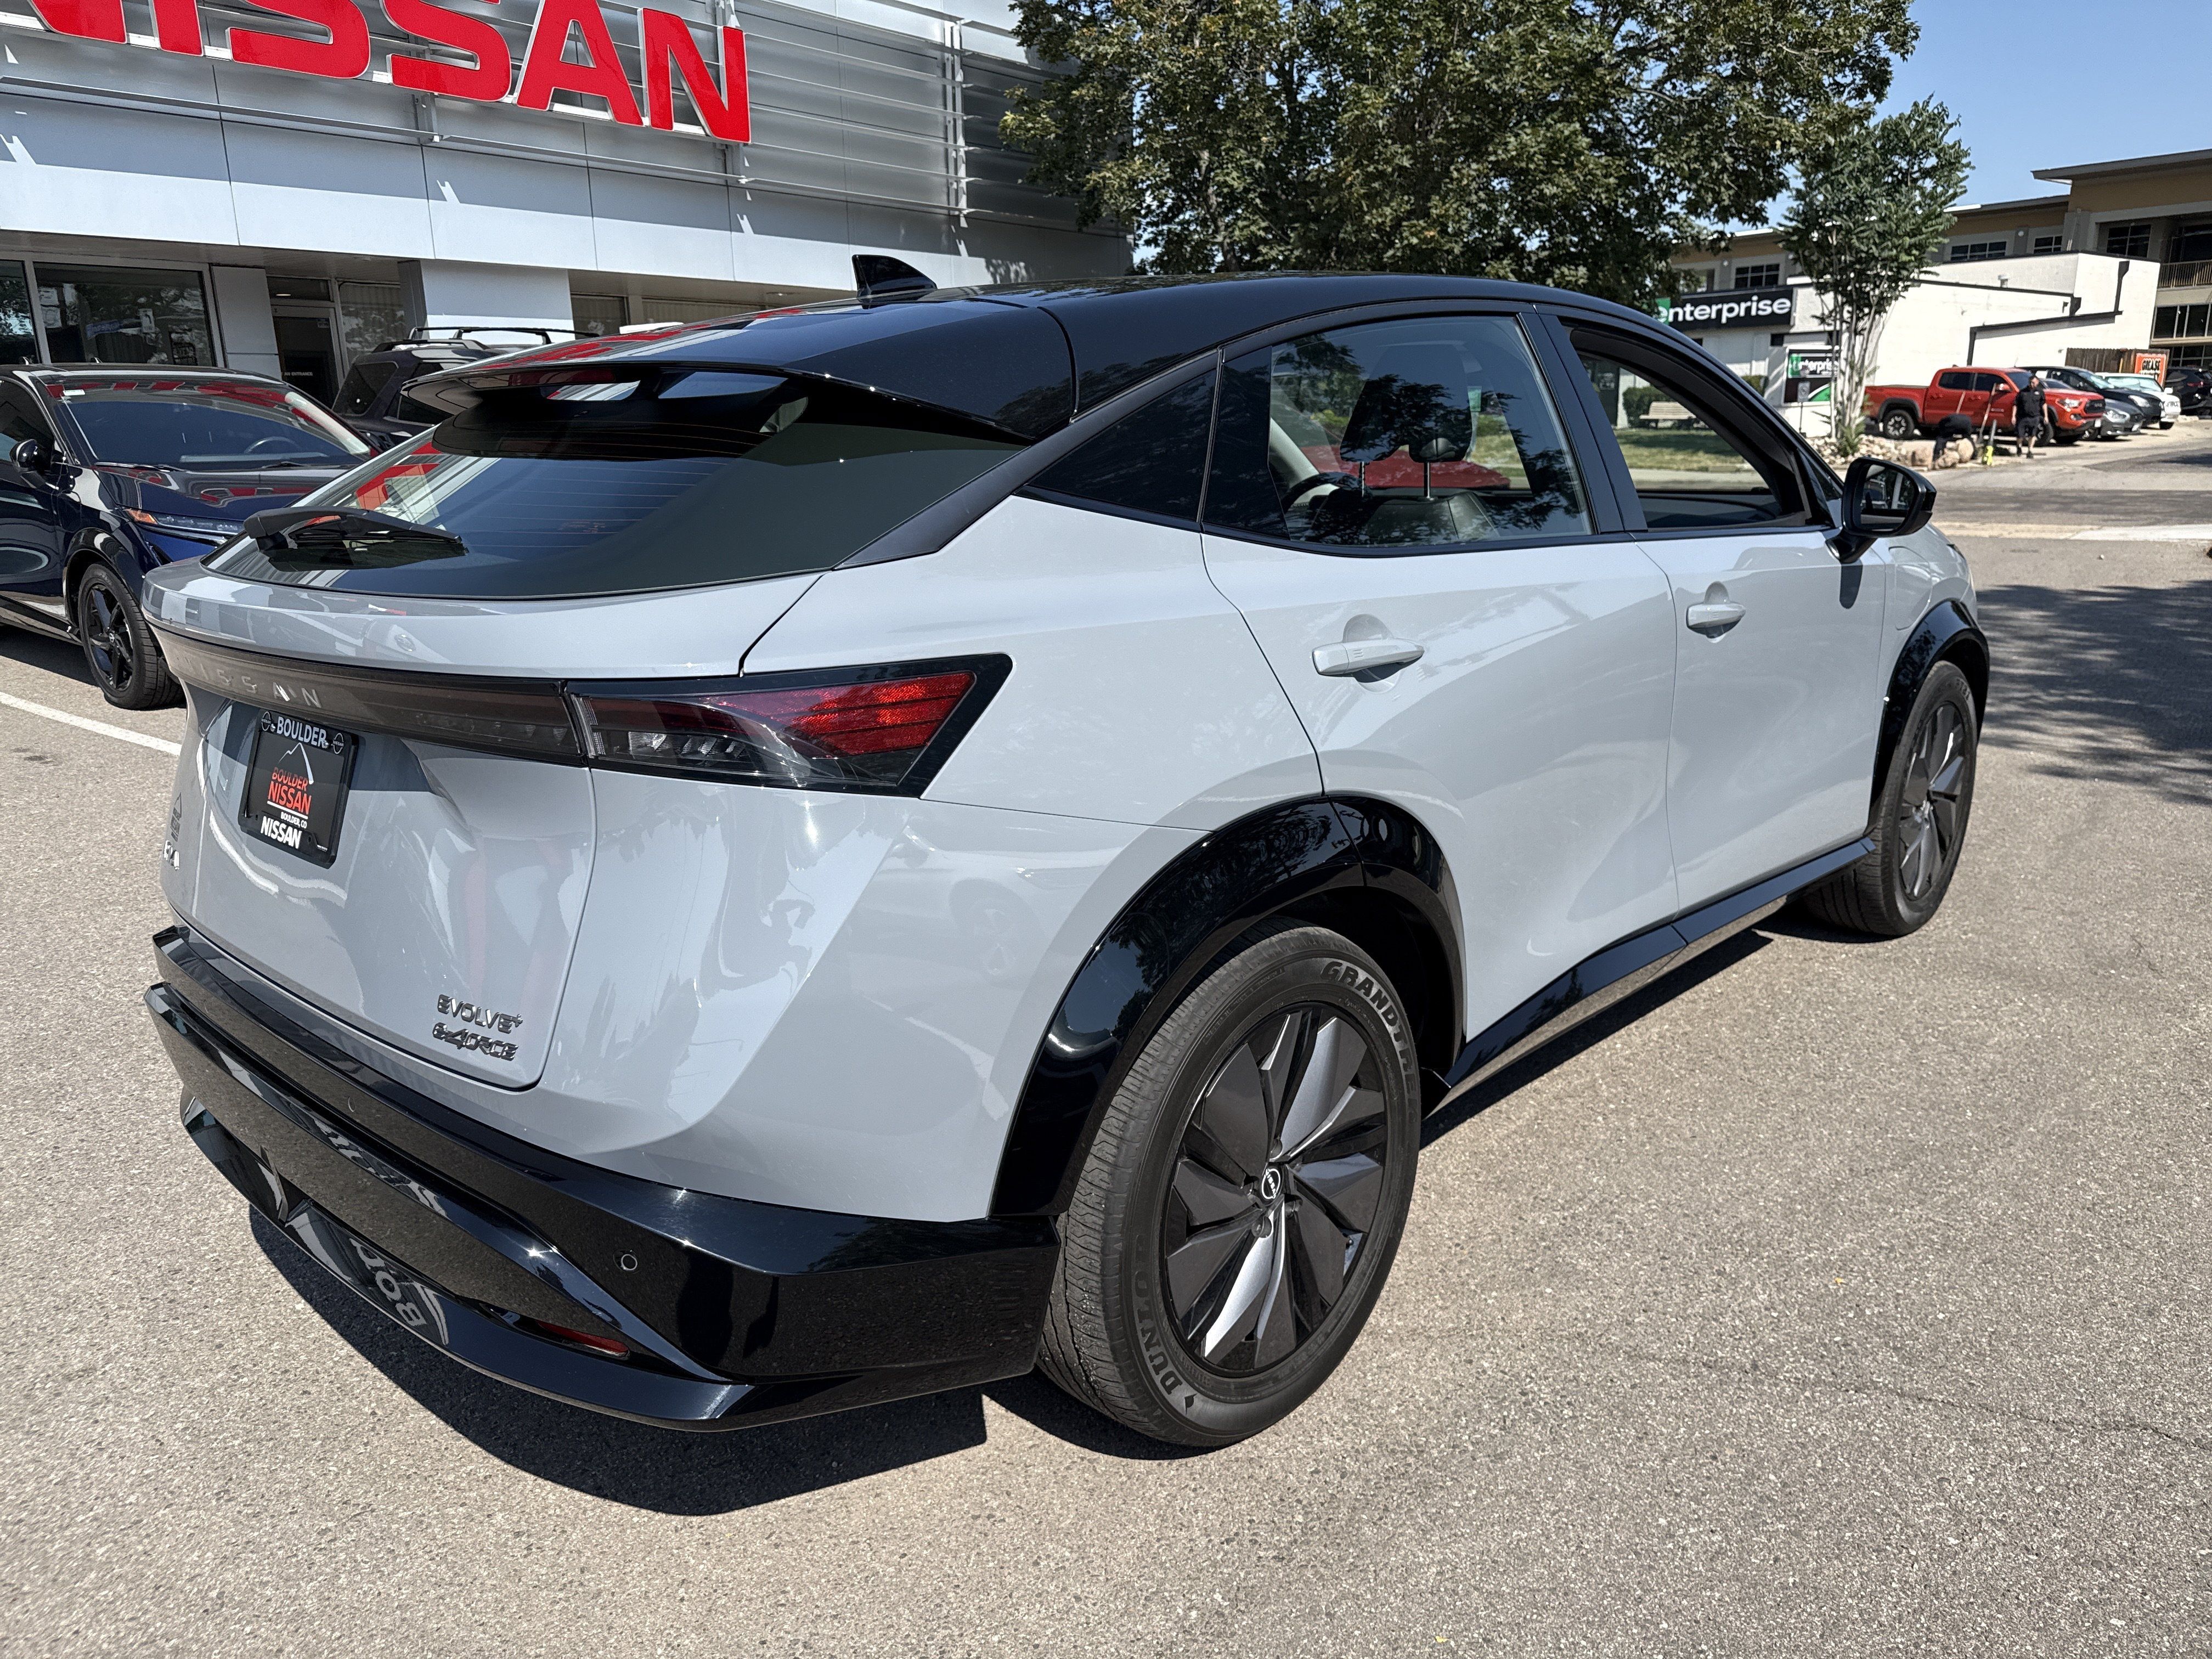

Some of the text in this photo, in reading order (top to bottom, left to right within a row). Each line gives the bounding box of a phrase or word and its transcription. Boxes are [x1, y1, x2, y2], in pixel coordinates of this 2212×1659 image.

[276, 716, 329, 749] BOULDER
[272, 767, 308, 791] BOULDER
[268, 781, 312, 815] NISSAN
[260, 816, 303, 849] NISSAN
[301, 820, 307, 829] CO
